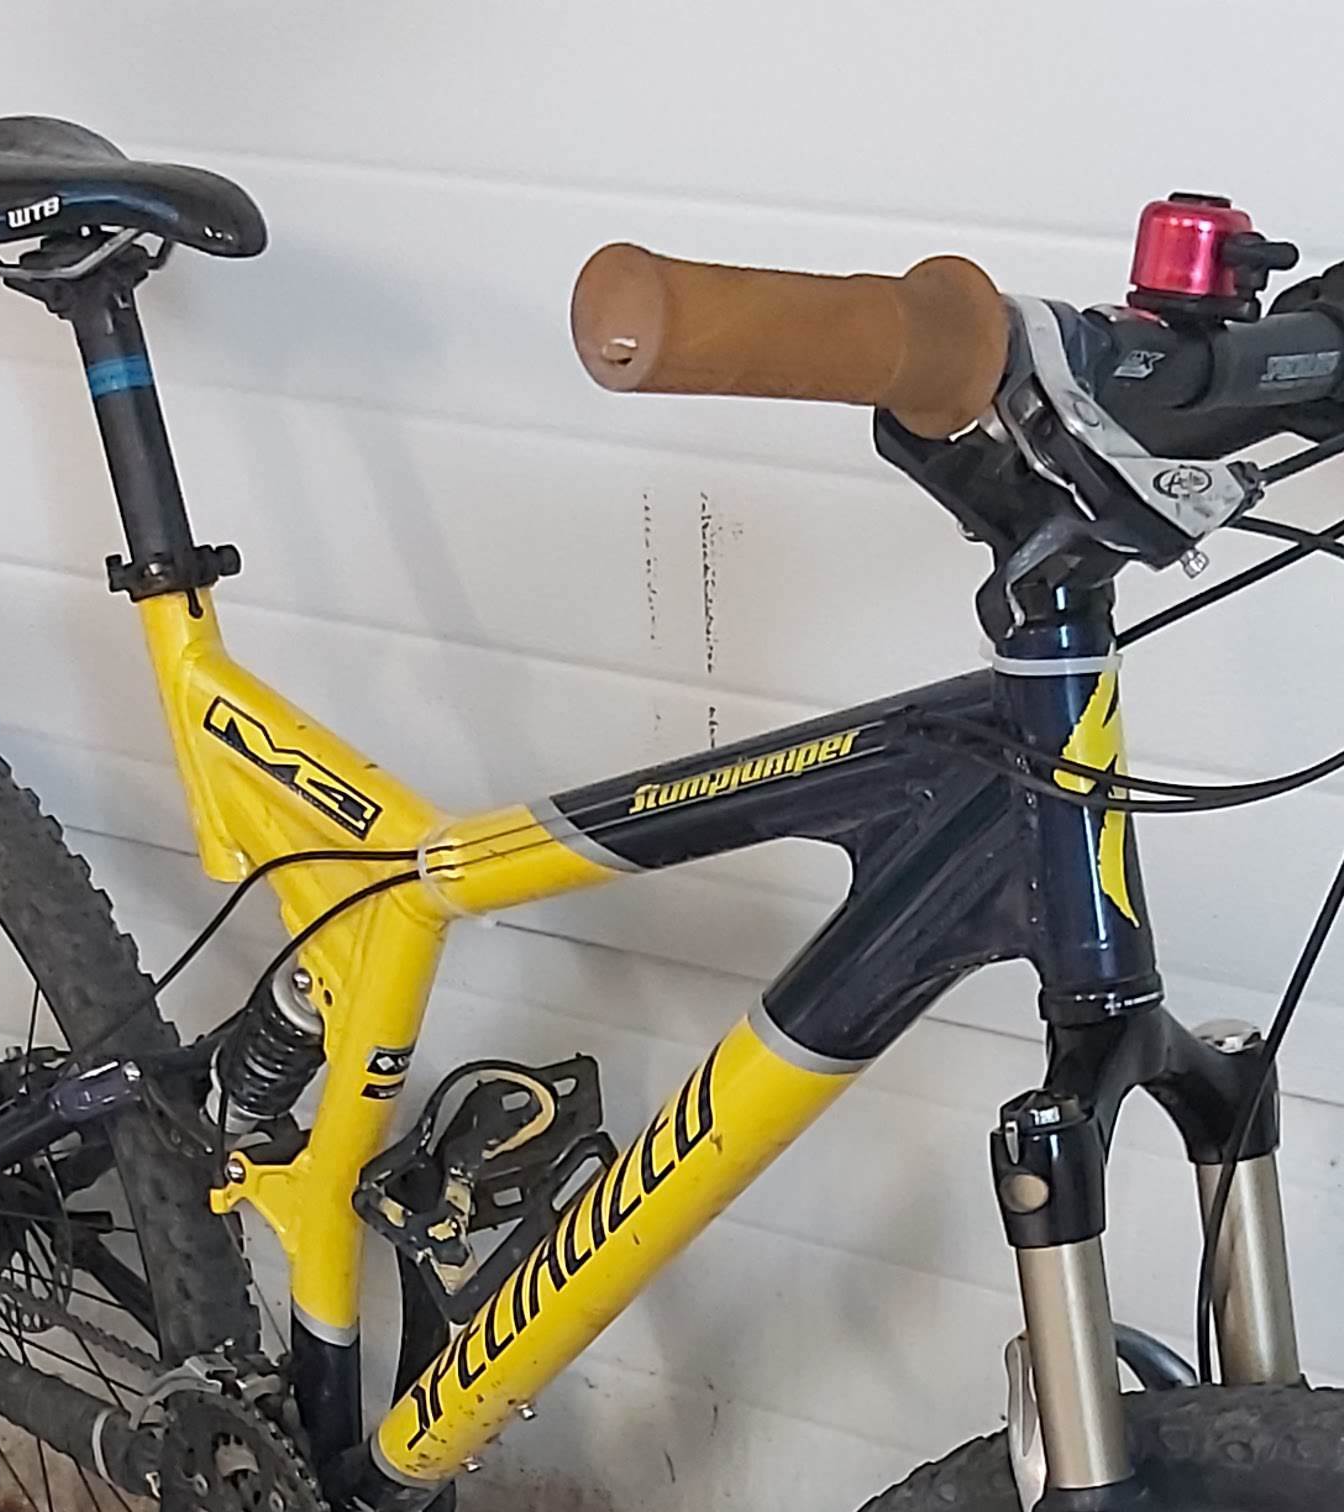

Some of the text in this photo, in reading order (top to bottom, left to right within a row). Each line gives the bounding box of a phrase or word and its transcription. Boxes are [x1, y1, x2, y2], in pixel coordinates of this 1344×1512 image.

[7, 196, 60, 228] WTB
[628, 730, 860, 814] Stumpjumper
[407, 1042, 723, 1451] SPECIALIZED
